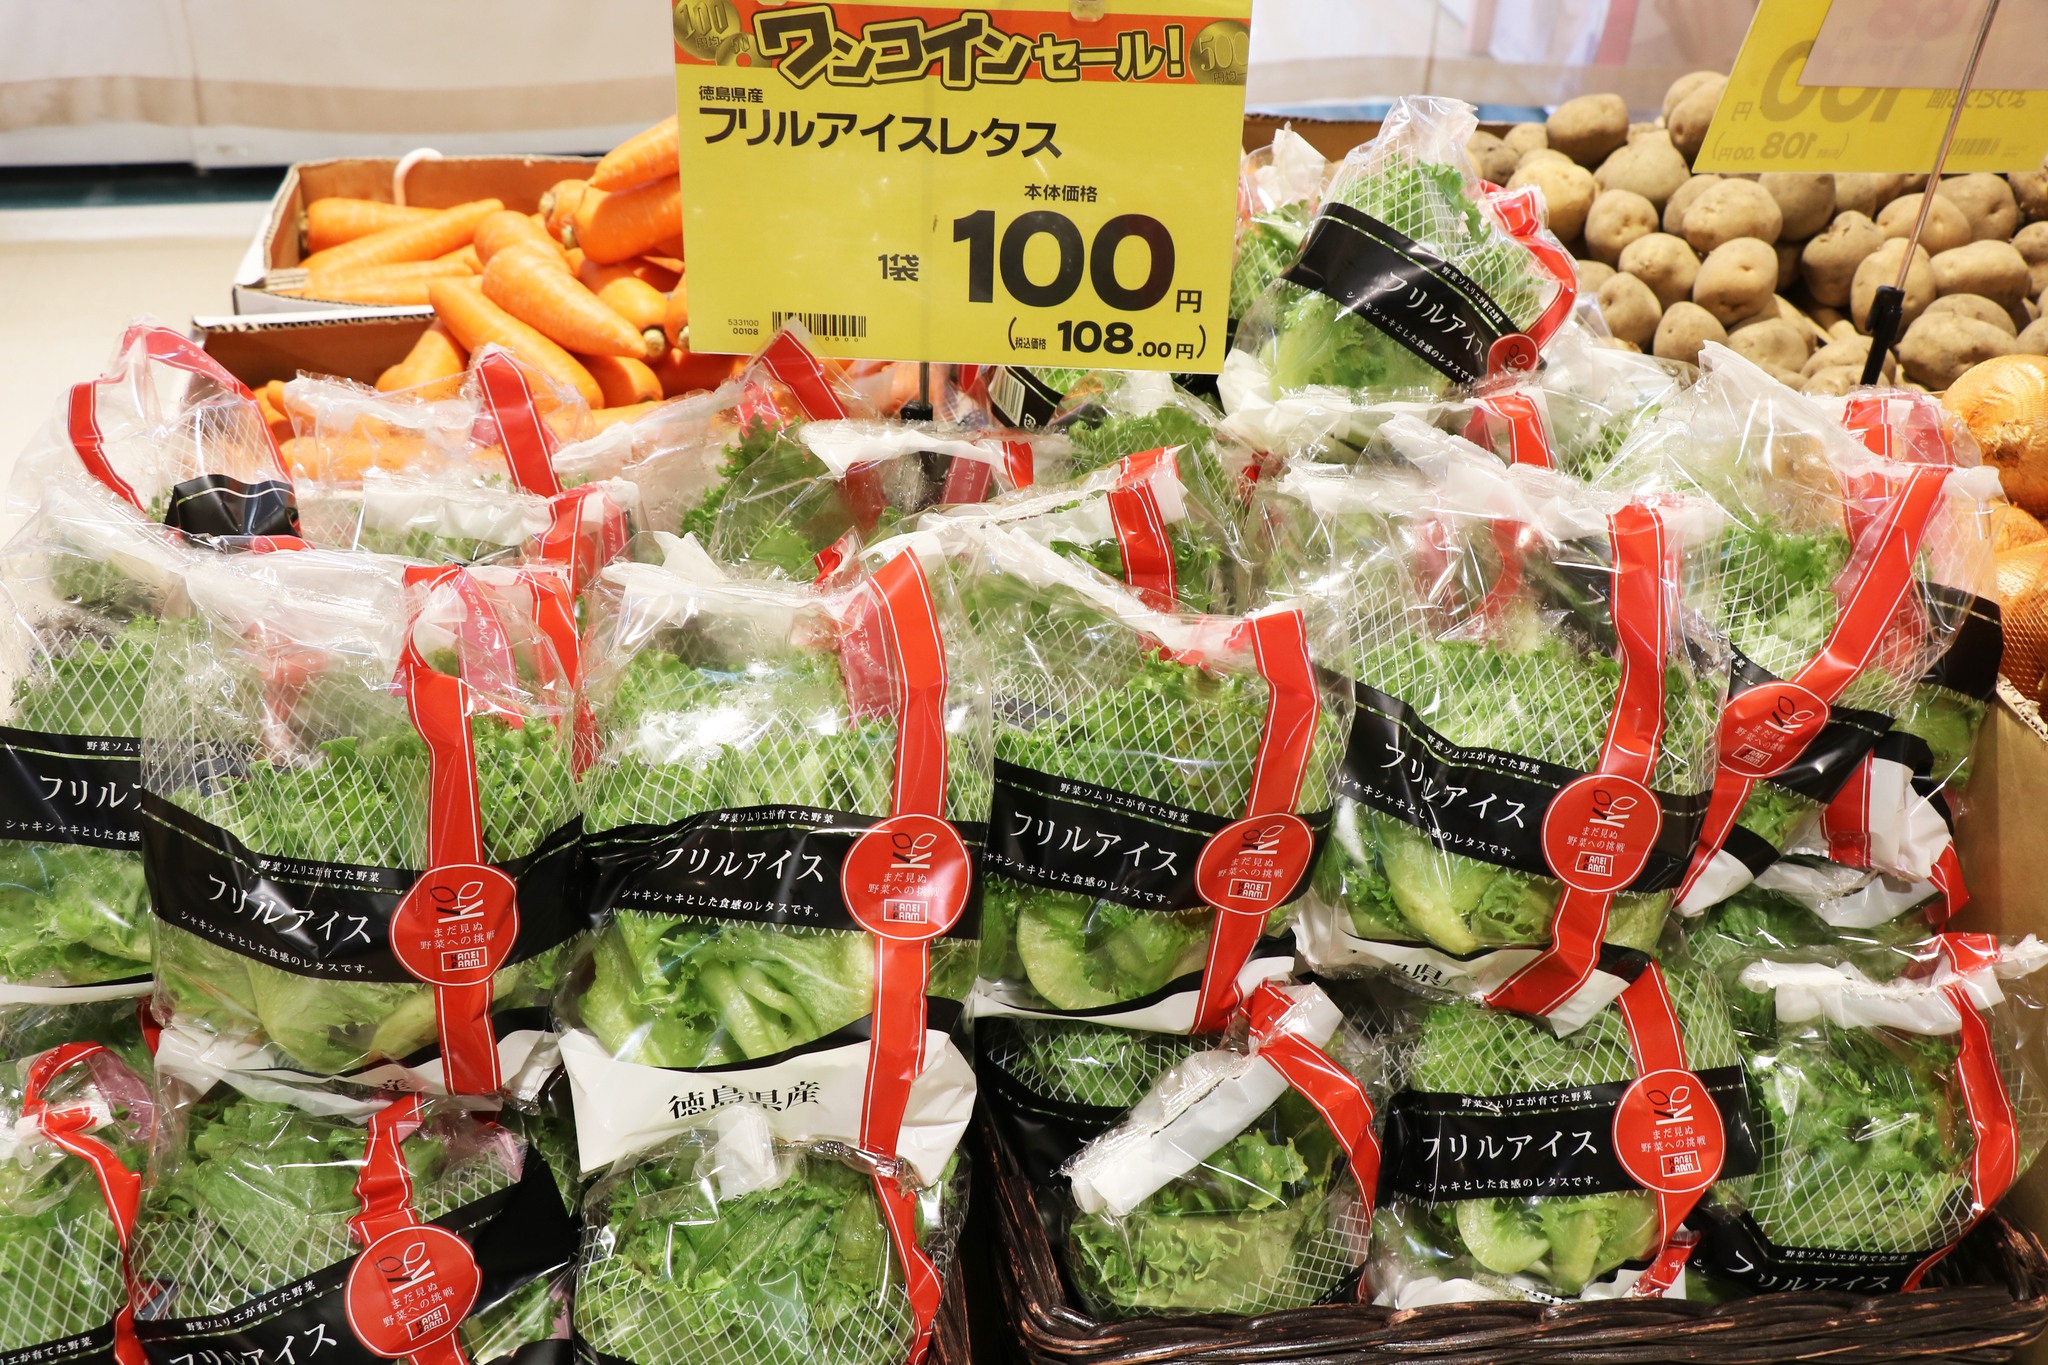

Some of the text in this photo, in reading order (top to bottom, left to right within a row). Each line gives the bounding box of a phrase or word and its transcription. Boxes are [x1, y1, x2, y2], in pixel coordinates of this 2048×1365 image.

[698, 85, 764, 104] 徳島県産
[699, 106, 1063, 159] フリルアイスレタス
[1024, 183, 1098, 202] 本体価格
[878, 253, 920, 282] 1袋
[727, 318, 760, 327] 5331100
[732, 327, 759, 336] 00108
[1427, 733, 1542, 776] 野菜ソムリエが育てた野菜
[1380, 743, 1526, 829] フリルアイス
[1060, 782, 1190, 824] 野菜ソムリエが育てた野菜
[5, 819, 141, 842] シャキシャキとした食感
[718, 809, 835, 825] 野菜ソムリエが育てた野菜
[1009, 810, 1178, 877] フリルアイス
[1566, 835, 1626, 853] 野菜への挑戦
[1581, 826, 1618, 839] まだ見ぬ
[258, 859, 381, 884] 野菜ソムリエが育てた野菜
[656, 847, 824, 884] フリルアイス
[1217, 867, 1284, 879] 野菜への挑戦
[1231, 856, 1274, 867] まだ見ぬ
[883, 872, 927, 884] まだ見ぬ
[208, 873, 373, 944] フリルアイス
[621, 888, 820, 918] シャキシャキとした食感のレタスです。
[180, 910, 374, 974] シャキシャキとした食感のレタスです。
[433, 921, 484, 938] まだ見ぬ
[667, 1080, 822, 1120] 徳島県産
[1421, 1129, 1598, 1163] フリルアイス
[1640, 1135, 1707, 1153] 野菜への挑戦
[1652, 1125, 1694, 1140] まだ見ぬ
[1726, 1250, 1891, 1292] フリルアイス
[185, 1279, 317, 1332] 野菜ソムリエが育てた野菜
[382, 1286, 455, 1328] 野菜への挑戦
[391, 1282, 438, 1309] まだ見ぬ
